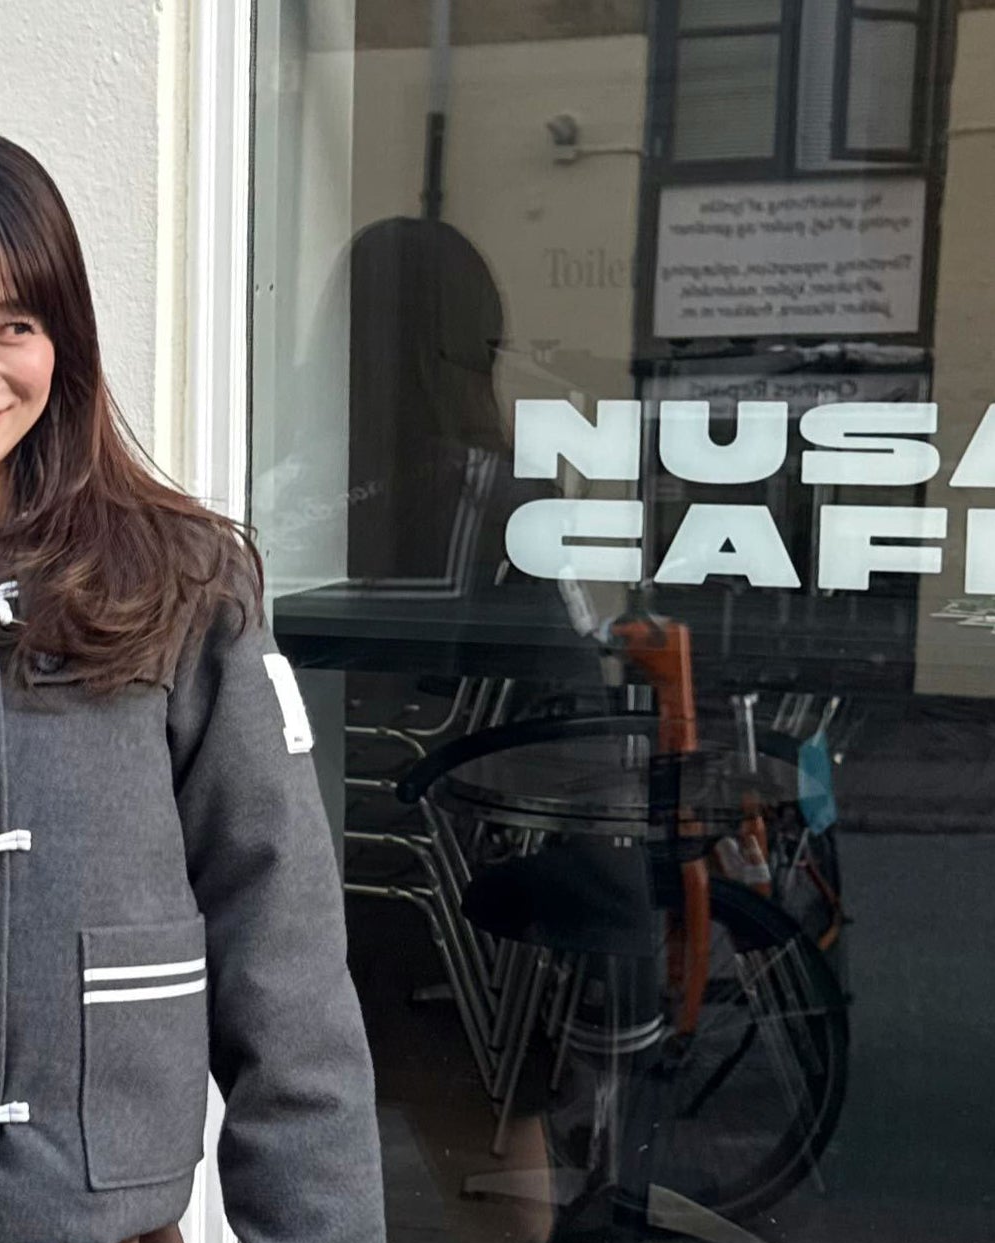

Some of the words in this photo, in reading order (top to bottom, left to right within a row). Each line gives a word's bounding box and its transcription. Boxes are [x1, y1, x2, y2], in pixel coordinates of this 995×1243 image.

[543, 247, 638, 290] Toile
[514, 399, 995, 487] NUS
[505, 498, 995, 594] CAF
